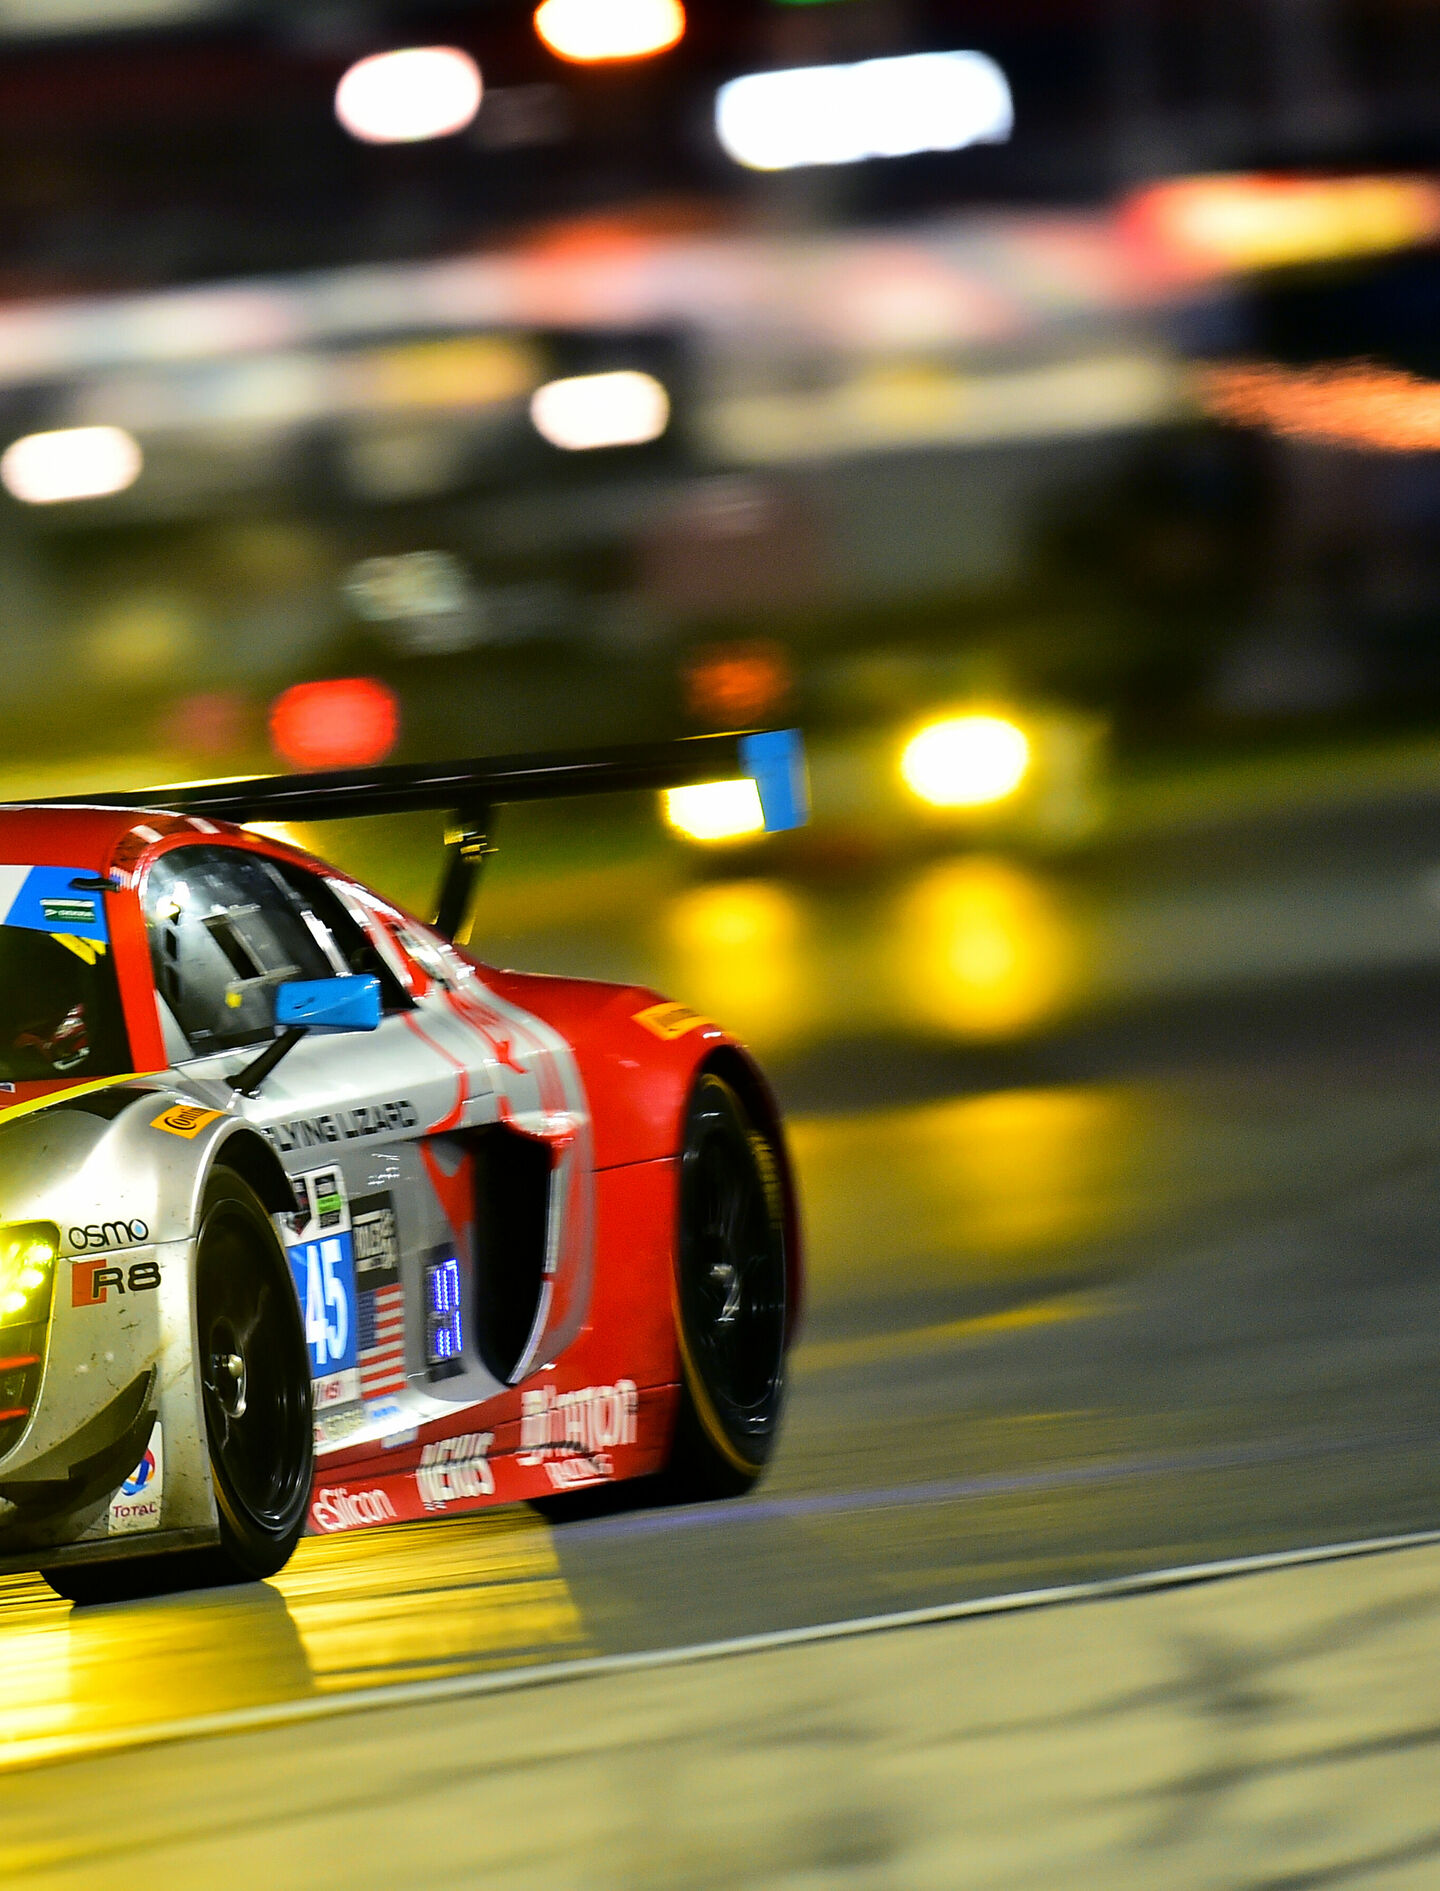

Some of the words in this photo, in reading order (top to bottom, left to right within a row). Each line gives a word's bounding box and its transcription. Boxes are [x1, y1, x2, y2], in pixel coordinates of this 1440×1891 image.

[335, 1099, 418, 1140] LIZARD
[91, 1261, 162, 1298] R8
[305, 1239, 349, 1365] 45
[112, 1502, 158, 1518] TOTAL
[312, 1487, 398, 1531] eSilicon
